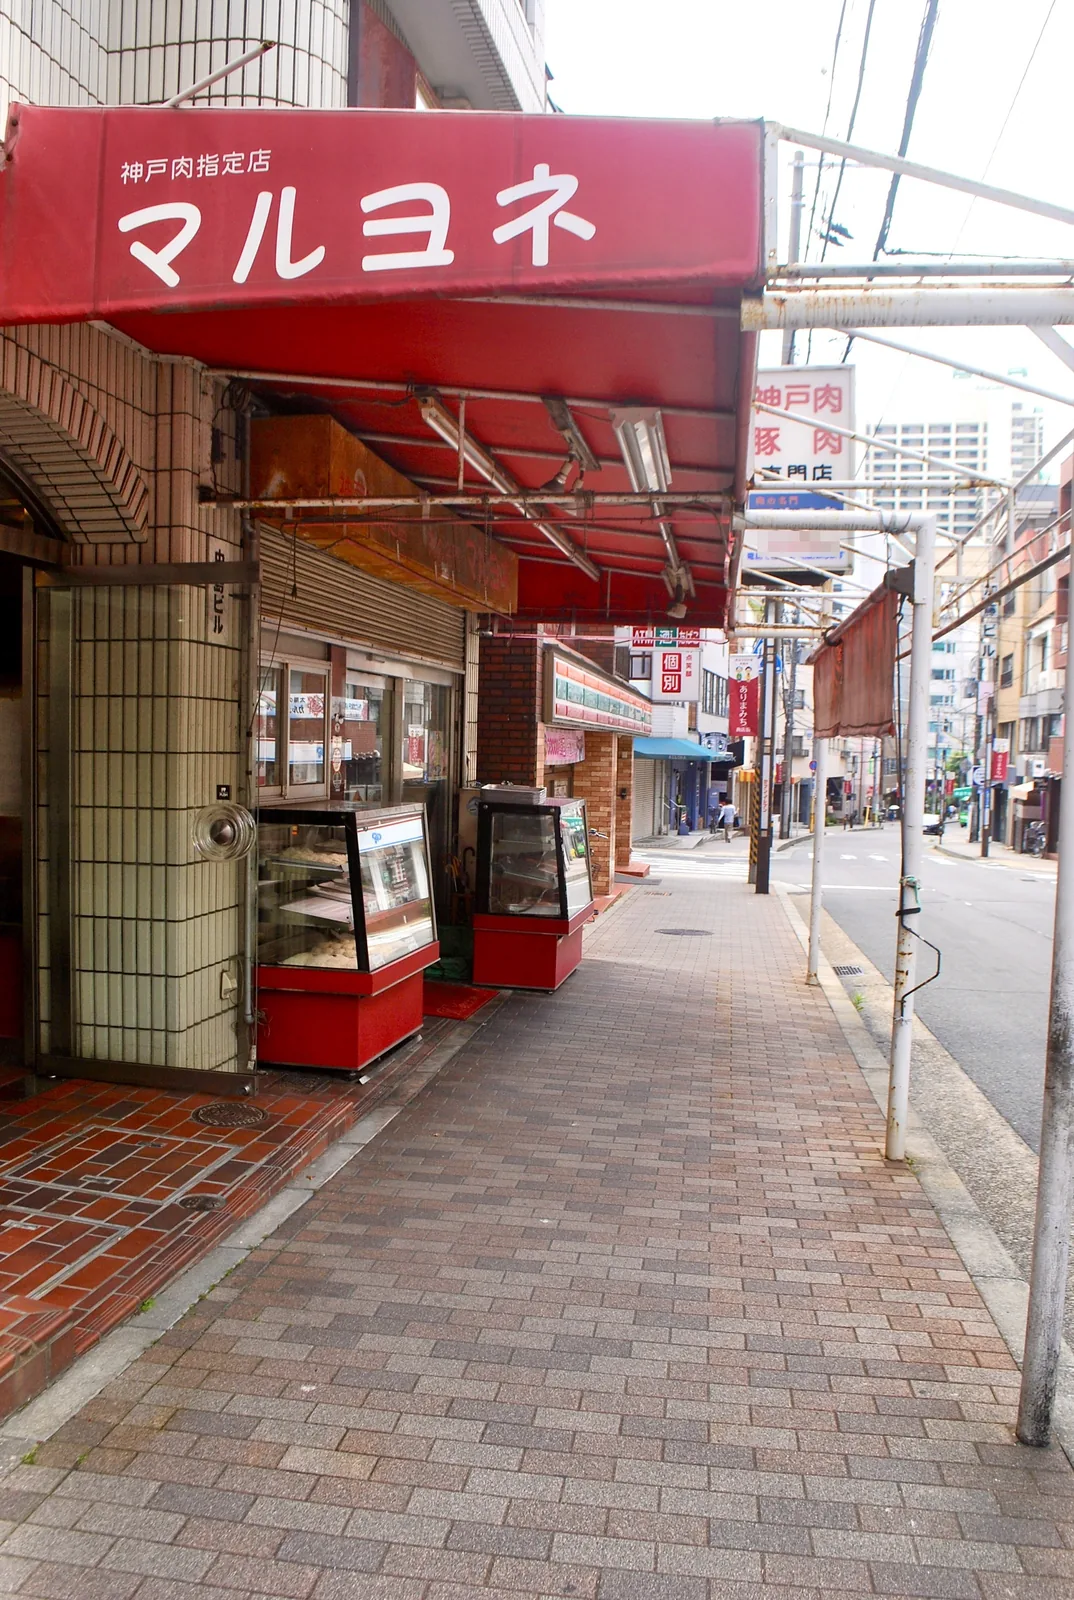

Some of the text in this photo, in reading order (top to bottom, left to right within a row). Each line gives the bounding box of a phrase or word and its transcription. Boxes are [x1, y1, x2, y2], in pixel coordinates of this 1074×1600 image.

[120, 148, 272, 185] 神戸肉指定店
[118, 163, 596, 288] マルヨネ
[755, 383, 842, 414] 神戸肉
[633, 629, 653, 644] ATM
[663, 654, 679, 691] 個別
[738, 685, 748, 727] ありまみち
